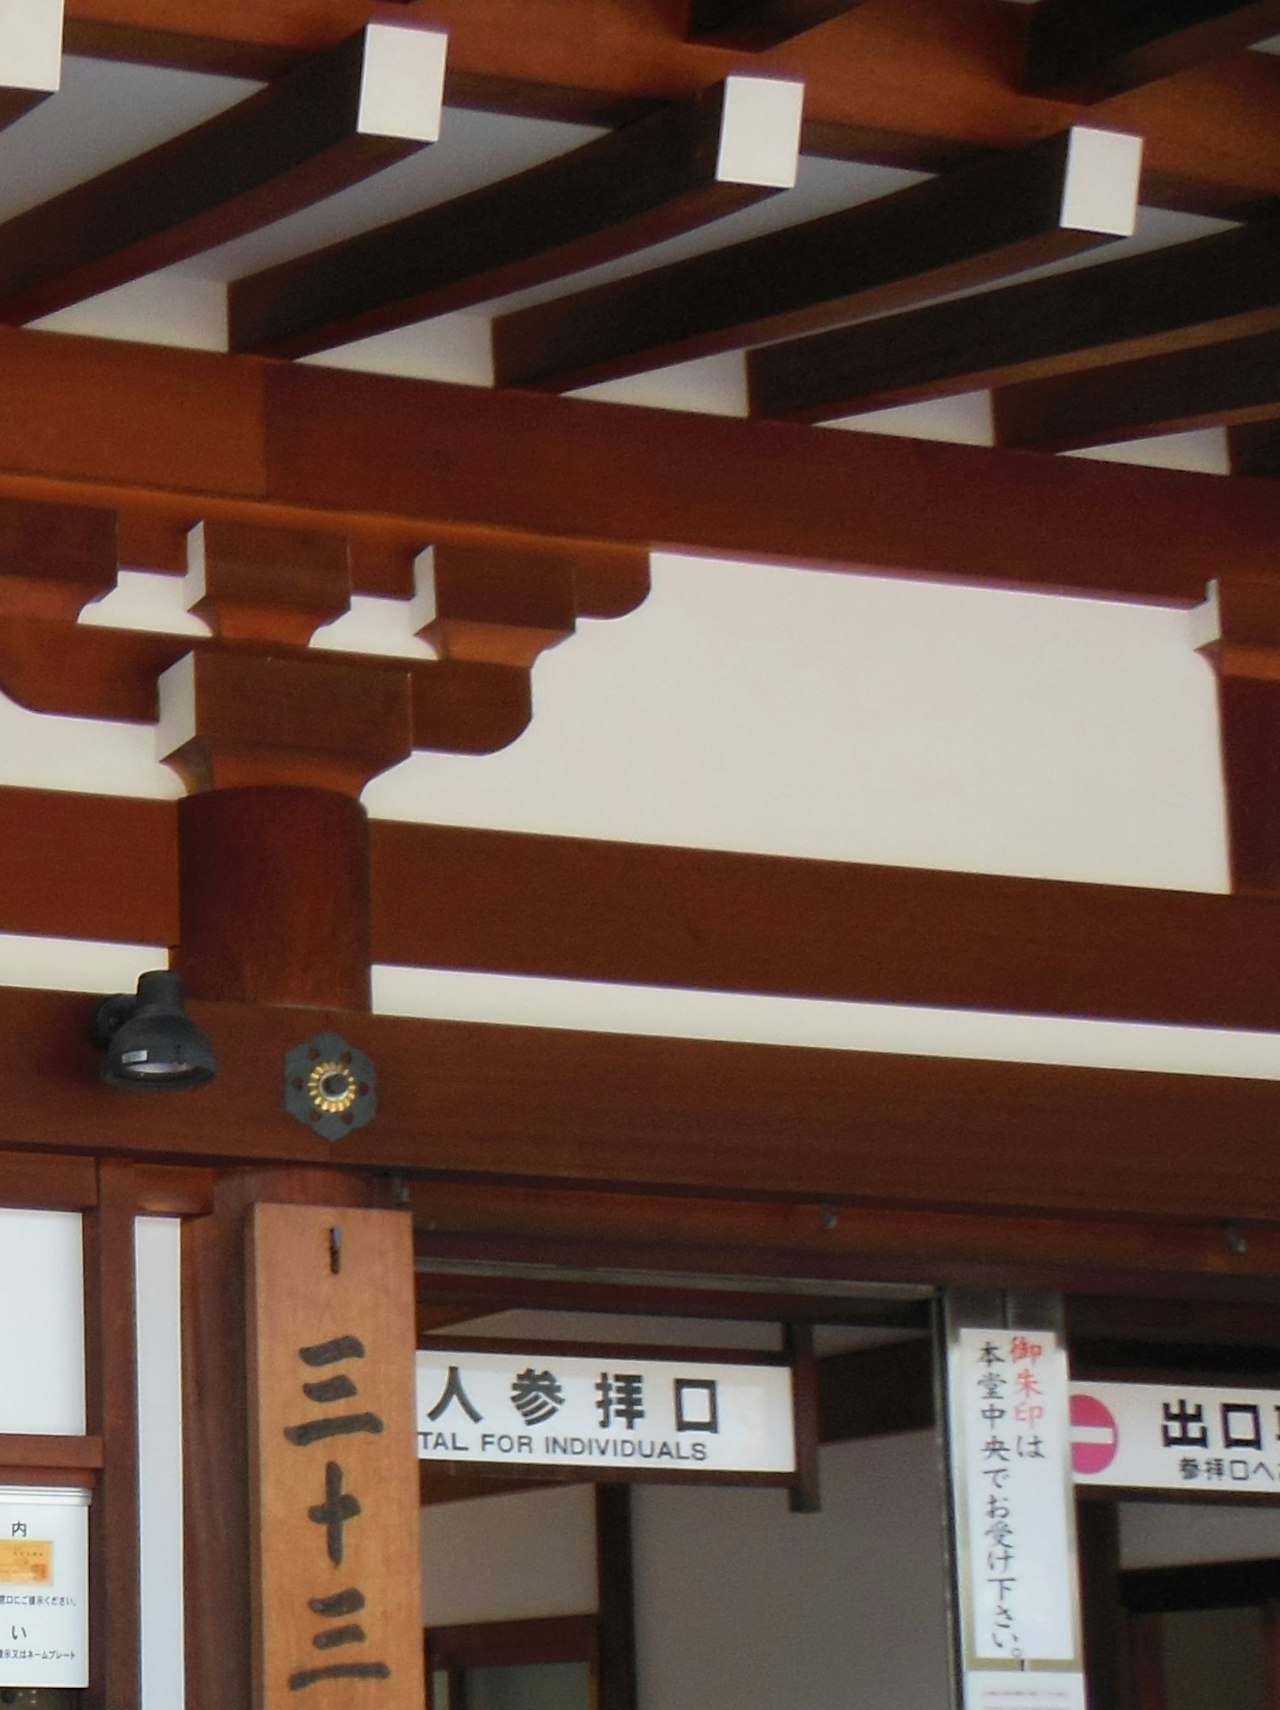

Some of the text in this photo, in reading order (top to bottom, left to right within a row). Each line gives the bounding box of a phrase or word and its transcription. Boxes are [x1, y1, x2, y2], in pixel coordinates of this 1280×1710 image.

[426, 1365, 719, 1434] 人参拝口
[1010, 1336, 1046, 1459] 御朱印は
[1161, 1398, 1280, 1451] 出口
[481, 1434, 533, 1454] FOR
[545, 1436, 707, 1461] INDIVIDUALS
[283, 1334, 391, 1691] 三十三
